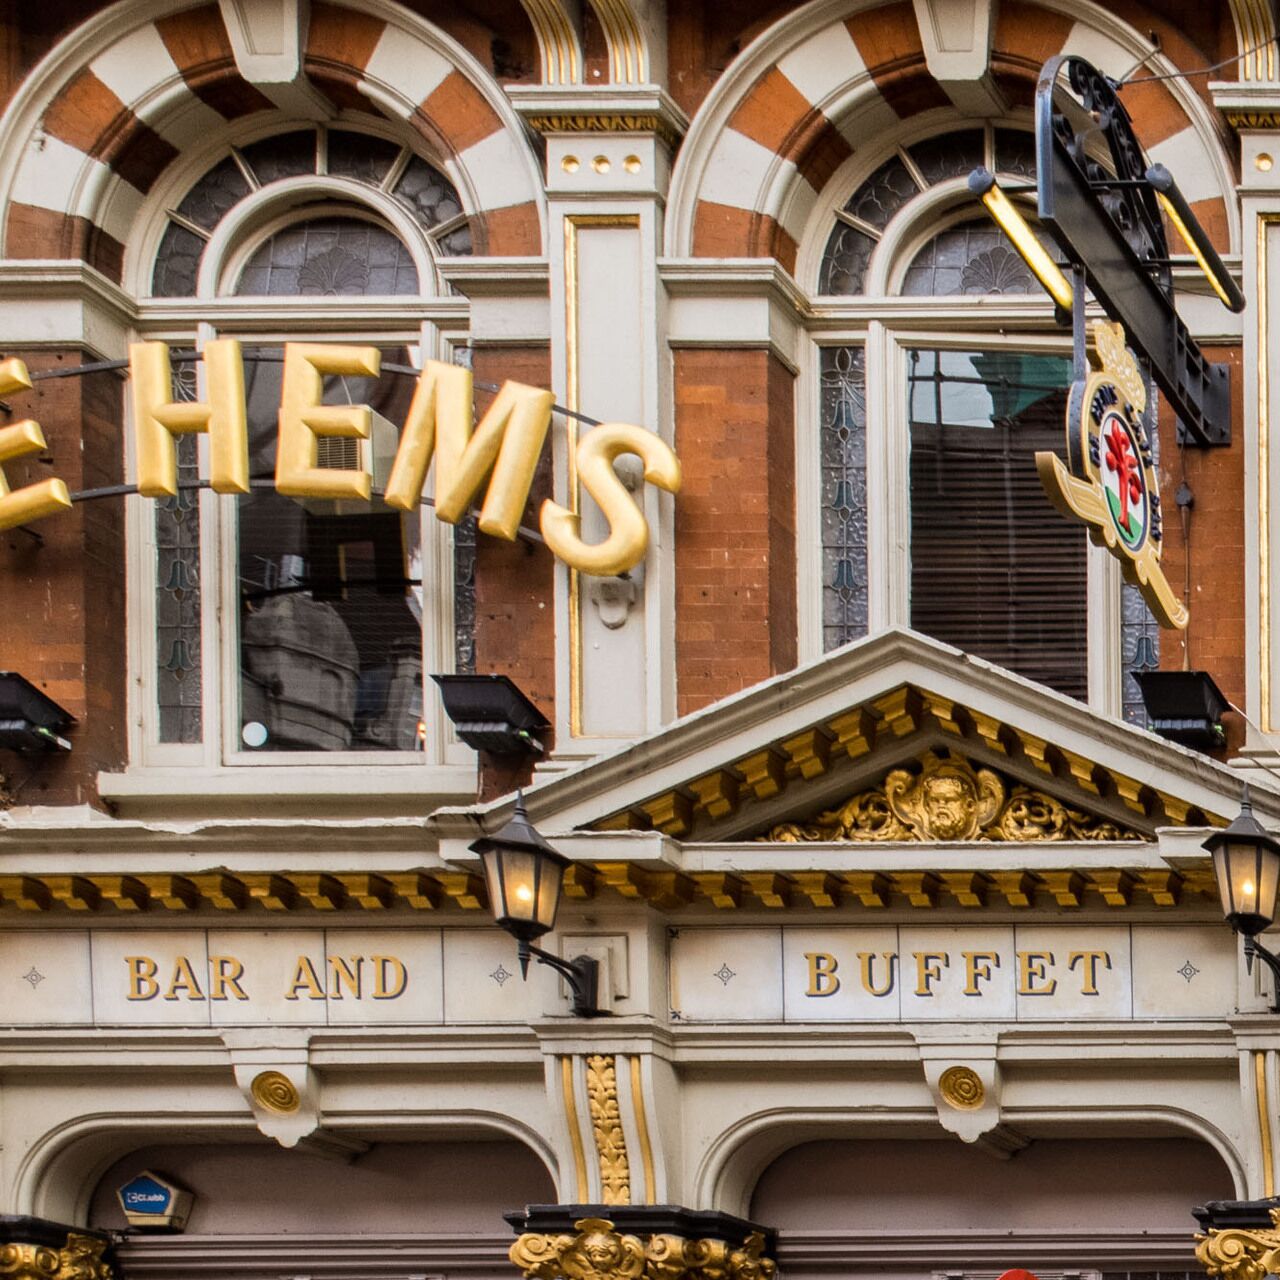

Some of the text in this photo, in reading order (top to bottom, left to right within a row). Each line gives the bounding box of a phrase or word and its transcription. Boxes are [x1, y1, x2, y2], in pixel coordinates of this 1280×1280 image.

[129, 339, 681, 577] HEMS
[125, 955, 408, 1000] BAR AND
[804, 951, 1112, 997] BUFFET
